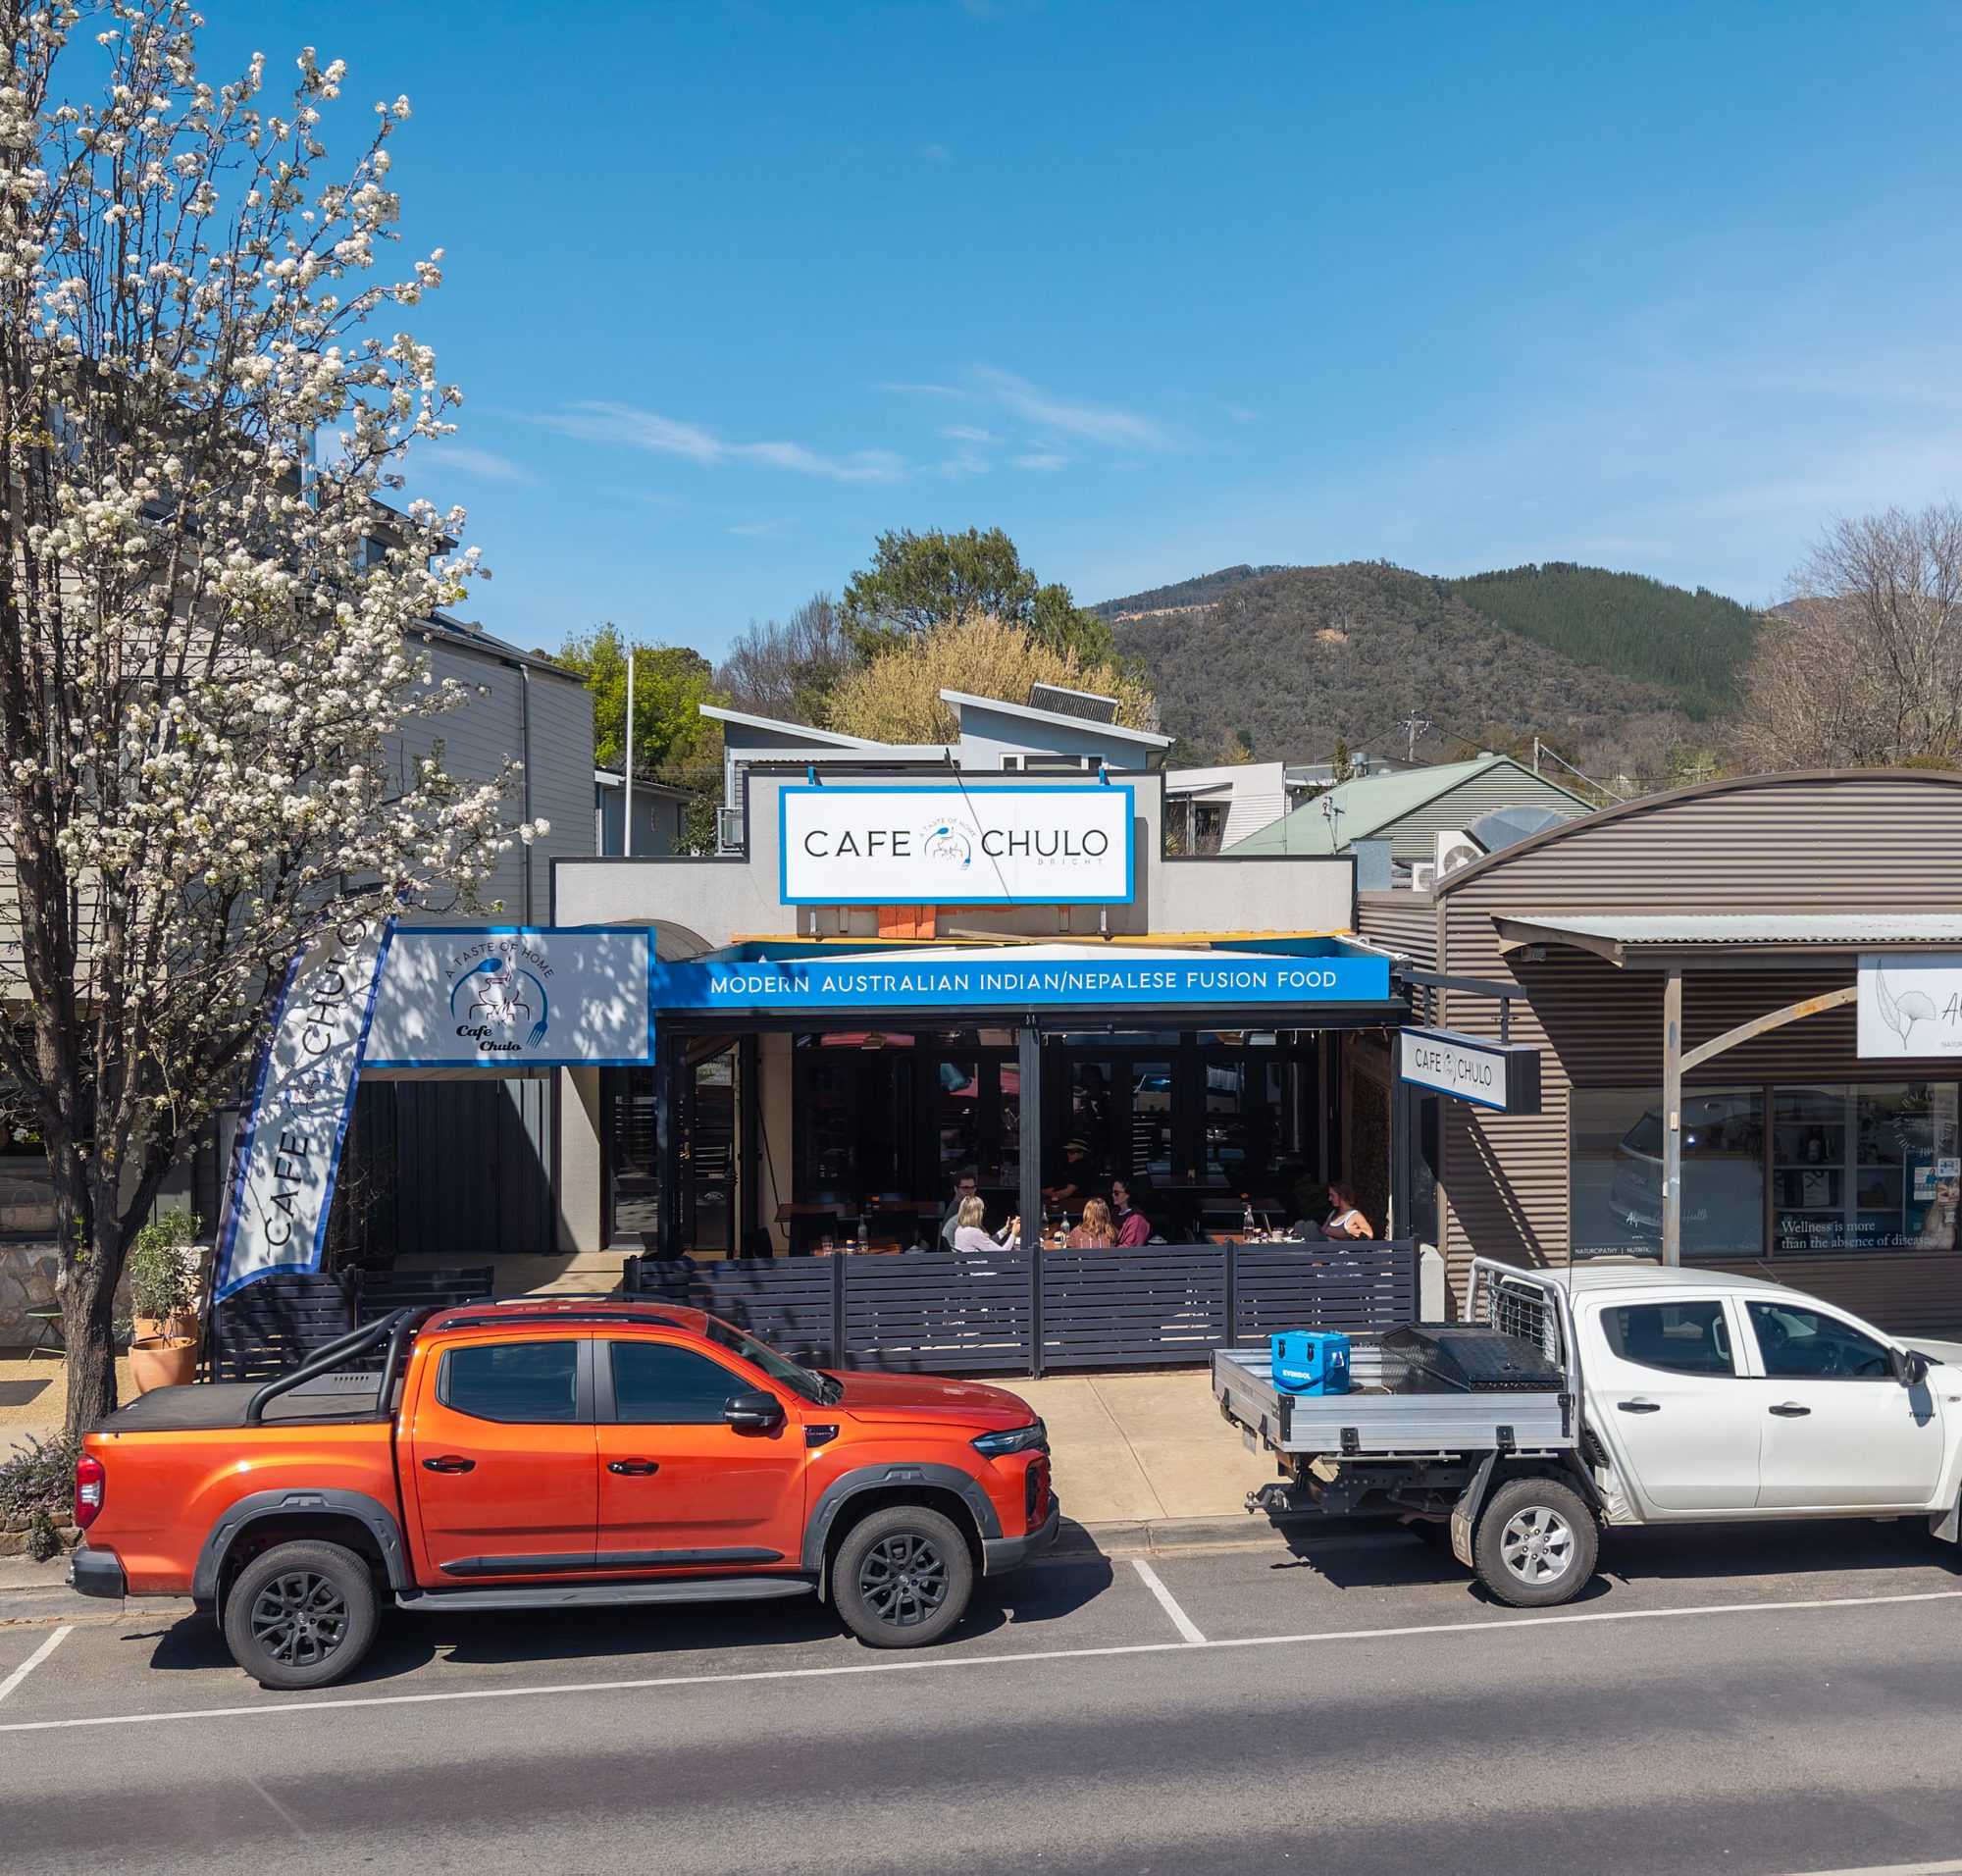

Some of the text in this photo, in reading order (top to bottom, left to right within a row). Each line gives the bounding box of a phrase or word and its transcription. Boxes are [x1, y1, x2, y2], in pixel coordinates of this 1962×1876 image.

[804, 830, 1109, 857] CAFE CHULO
[445, 942, 556, 979] A TASTE OF HOME
[710, 971, 1337, 994] MODERN AUSTRALIAN INDIAN/NEPALESE FUSION FOOD
[456, 1024, 493, 1041] Cafe
[479, 1040, 522, 1052] Chulo
[1416, 1048, 1492, 1086] CAFE CHULO
[264, 1131, 309, 1247] CAFE
[1781, 1221, 1876, 1232] Wellness is more
[1781, 1237, 1807, 1249] than
[1811, 1236, 1829, 1248] the
[1832, 1235, 1874, 1248] absence
[1878, 1233, 1890, 1246] of
